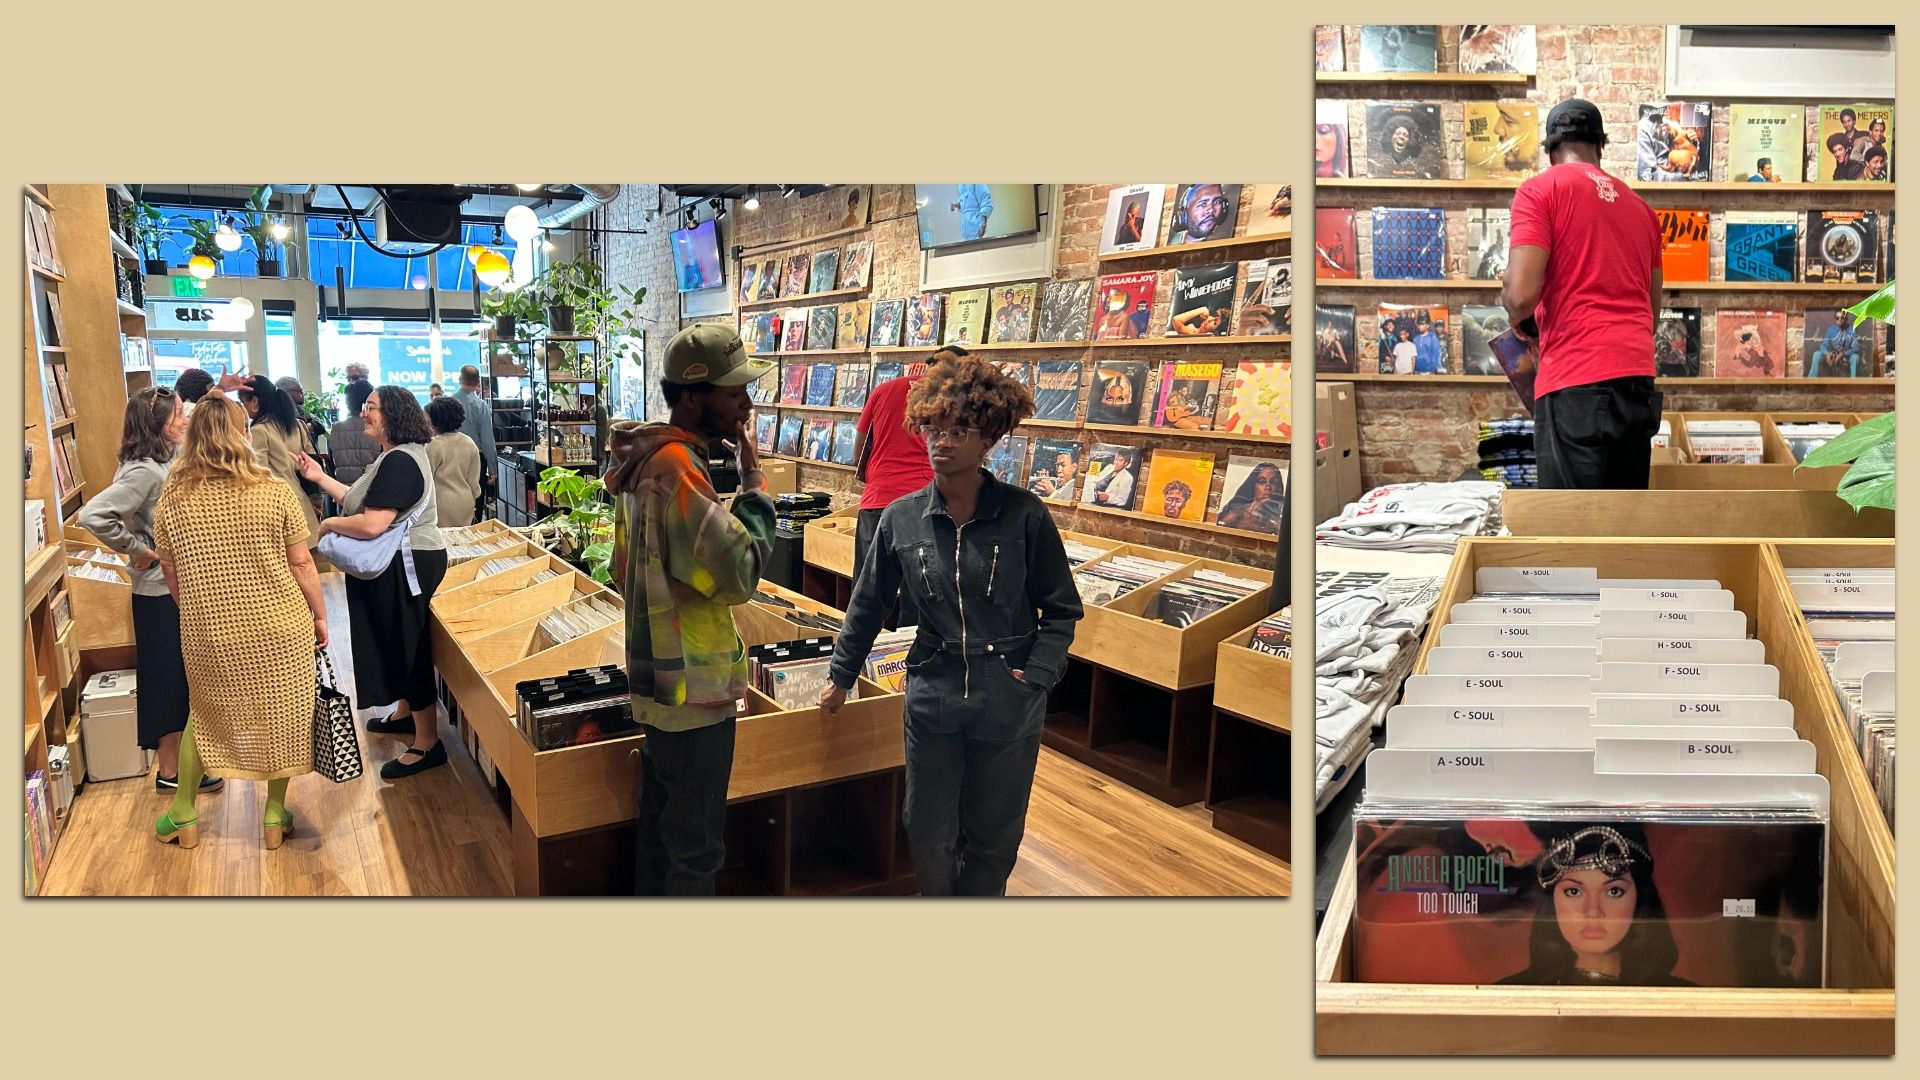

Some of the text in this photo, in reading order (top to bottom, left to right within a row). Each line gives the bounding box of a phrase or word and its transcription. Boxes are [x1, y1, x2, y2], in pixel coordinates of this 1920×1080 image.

[1824, 112, 1888, 120] THE METERS
[1102, 274, 1155, 286] SAMARA JOY
[1175, 276, 1196, 292] AMY
[1184, 276, 1234, 300] WINEHOUSE
[1174, 362, 1220, 378] MASEGO
[388, 370, 426, 383] NOW
[1695, 704, 1721, 712] SOUL
[1469, 711, 1495, 720] SOUL
[1704, 745, 1733, 754] SOUL
[1455, 756, 1485, 766] SOUL
[1388, 855, 1508, 892] ANGELA BOFILL
[1416, 892, 1478, 914] TOO TOUGH
